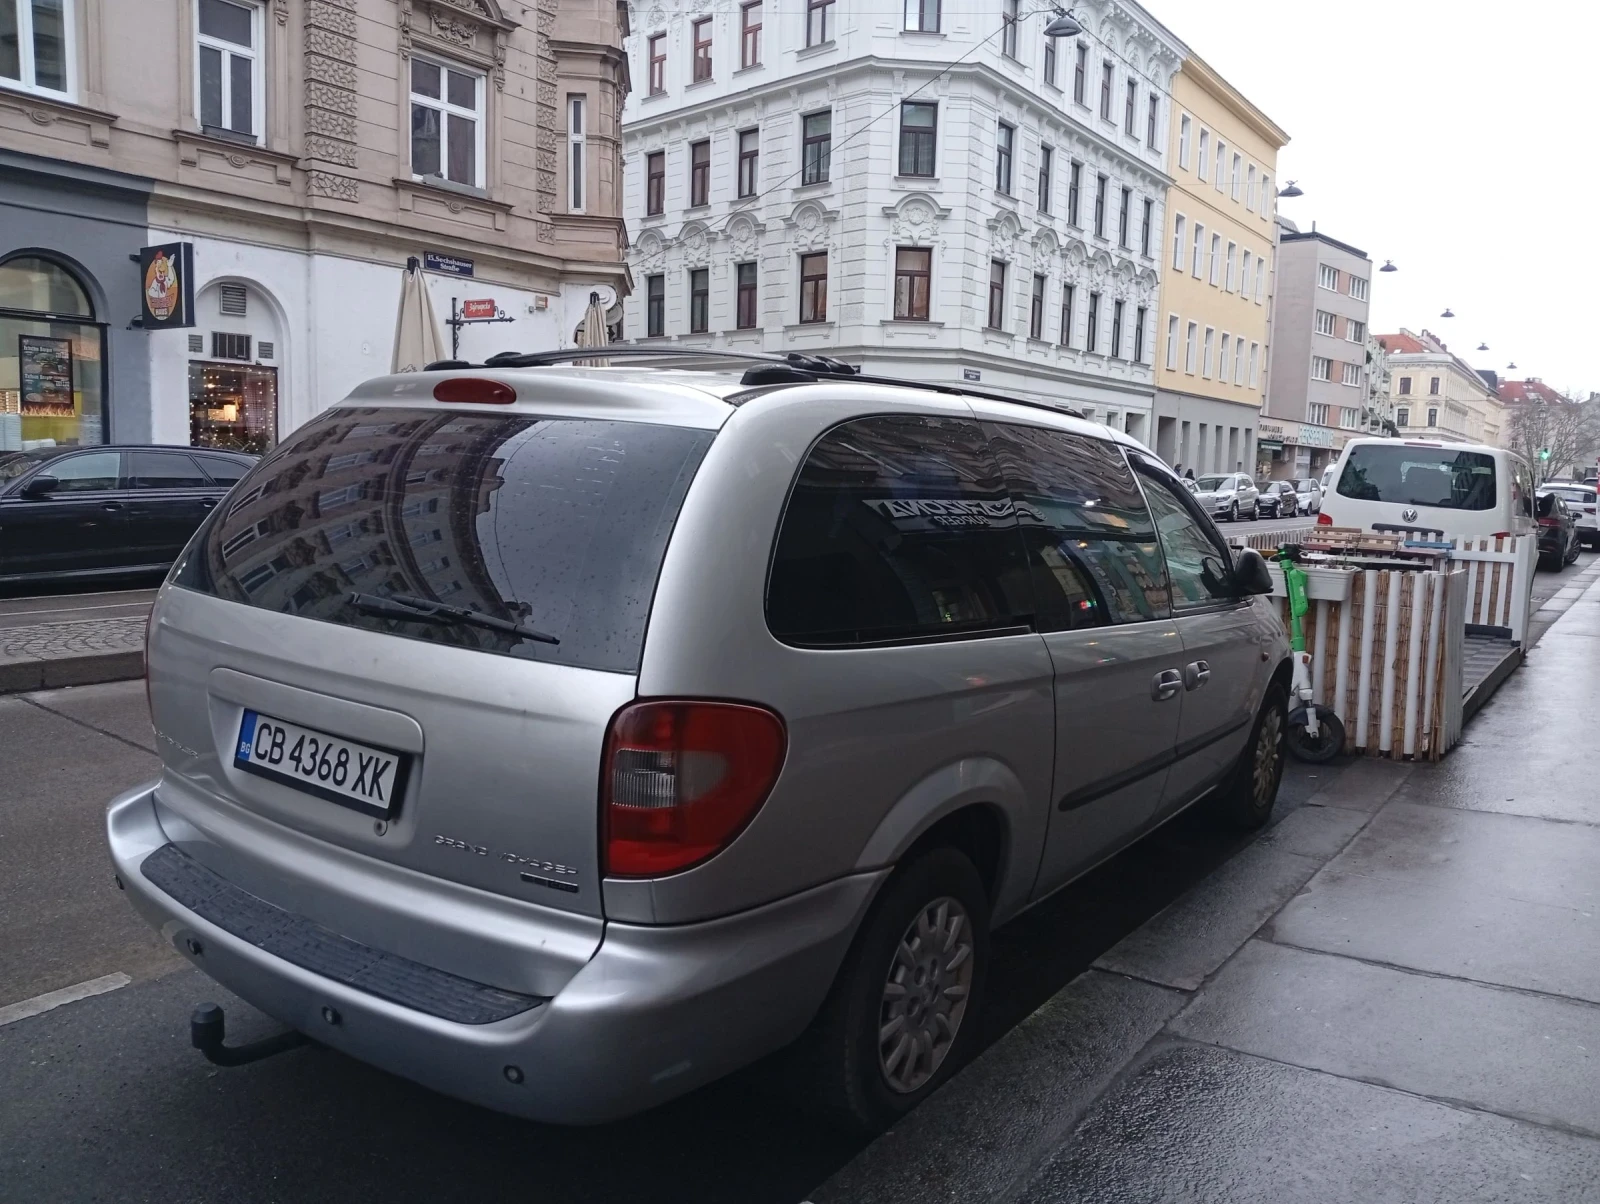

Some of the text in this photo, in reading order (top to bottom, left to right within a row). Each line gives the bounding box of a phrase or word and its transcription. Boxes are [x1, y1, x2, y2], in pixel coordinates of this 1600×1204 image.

[440, 263, 460, 273] Straße
[240, 741, 250, 754] BG
[254, 722, 286, 765] CB
[289, 734, 350, 787] 4368
[351, 752, 392, 801] XK
[434, 835, 578, 875] GRAND VOYAGER
